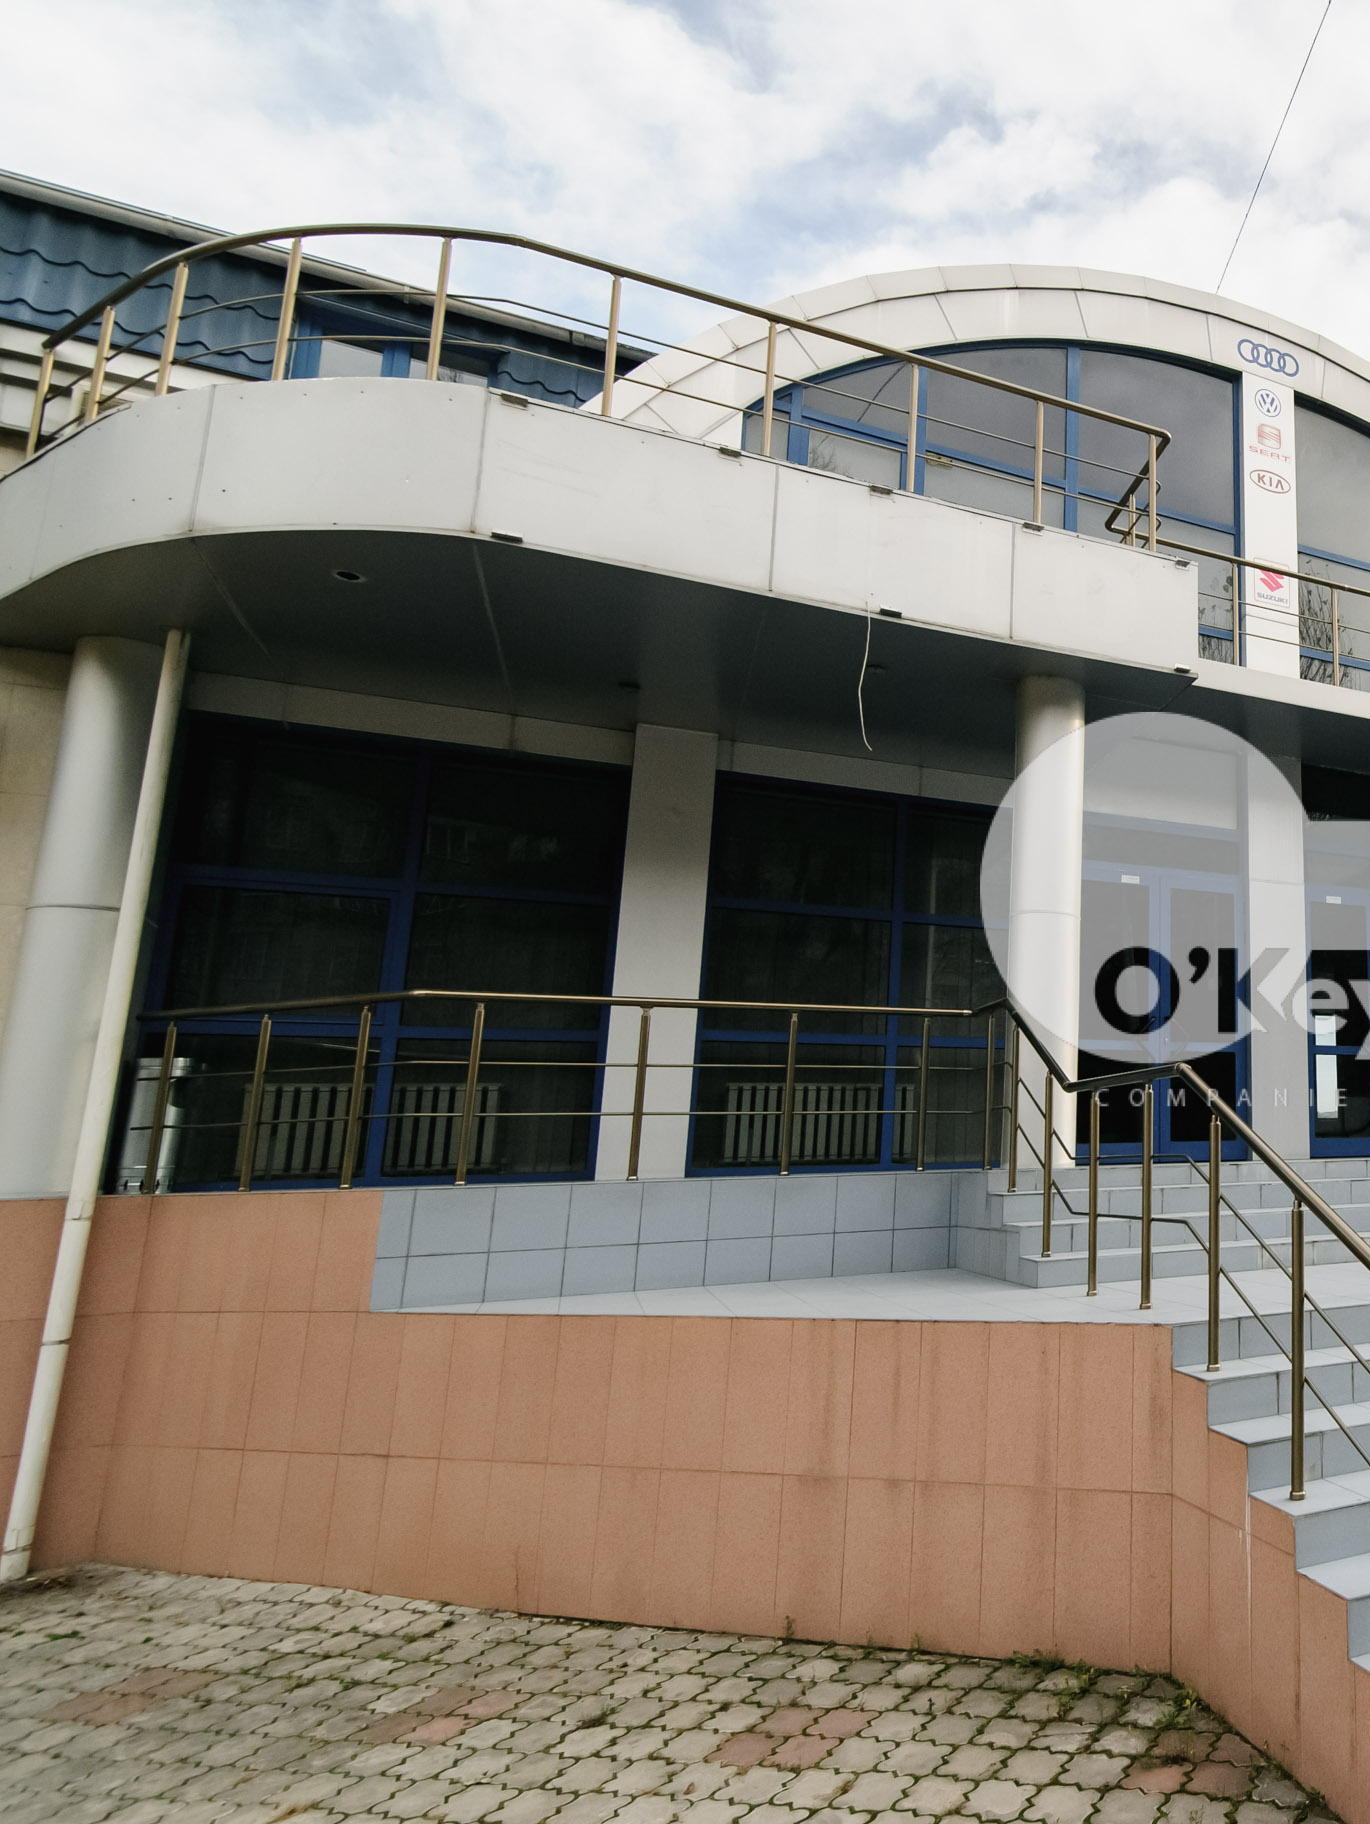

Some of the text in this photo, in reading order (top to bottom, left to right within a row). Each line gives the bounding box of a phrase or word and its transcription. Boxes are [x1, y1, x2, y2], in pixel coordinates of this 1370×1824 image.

[1249, 445, 1291, 462] SEAT
[1257, 473, 1284, 491] KIA
[1257, 592, 1288, 605] SUZUKI
